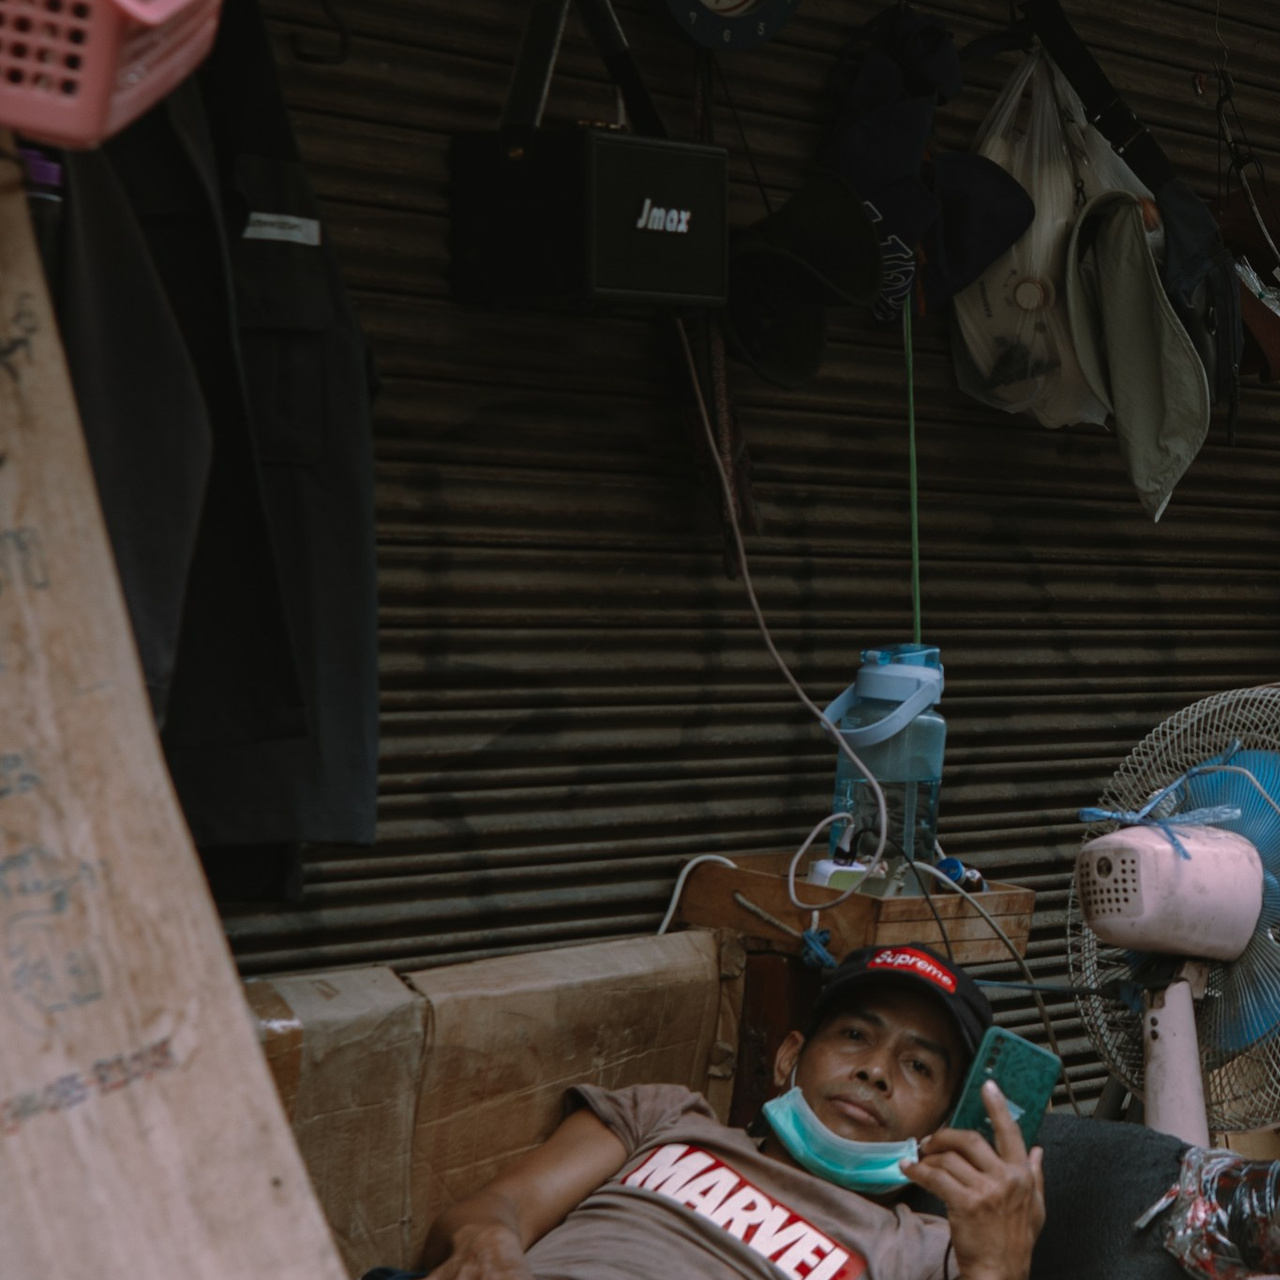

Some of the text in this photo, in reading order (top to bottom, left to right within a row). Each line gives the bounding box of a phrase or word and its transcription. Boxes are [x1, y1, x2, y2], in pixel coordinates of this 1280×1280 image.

[689, 12, 698, 26] 7
[722, 28, 732, 42] 6
[757, 22, 766, 36] 5
[636, 198, 692, 233] Jmax
[873, 950, 953, 986] Supreme
